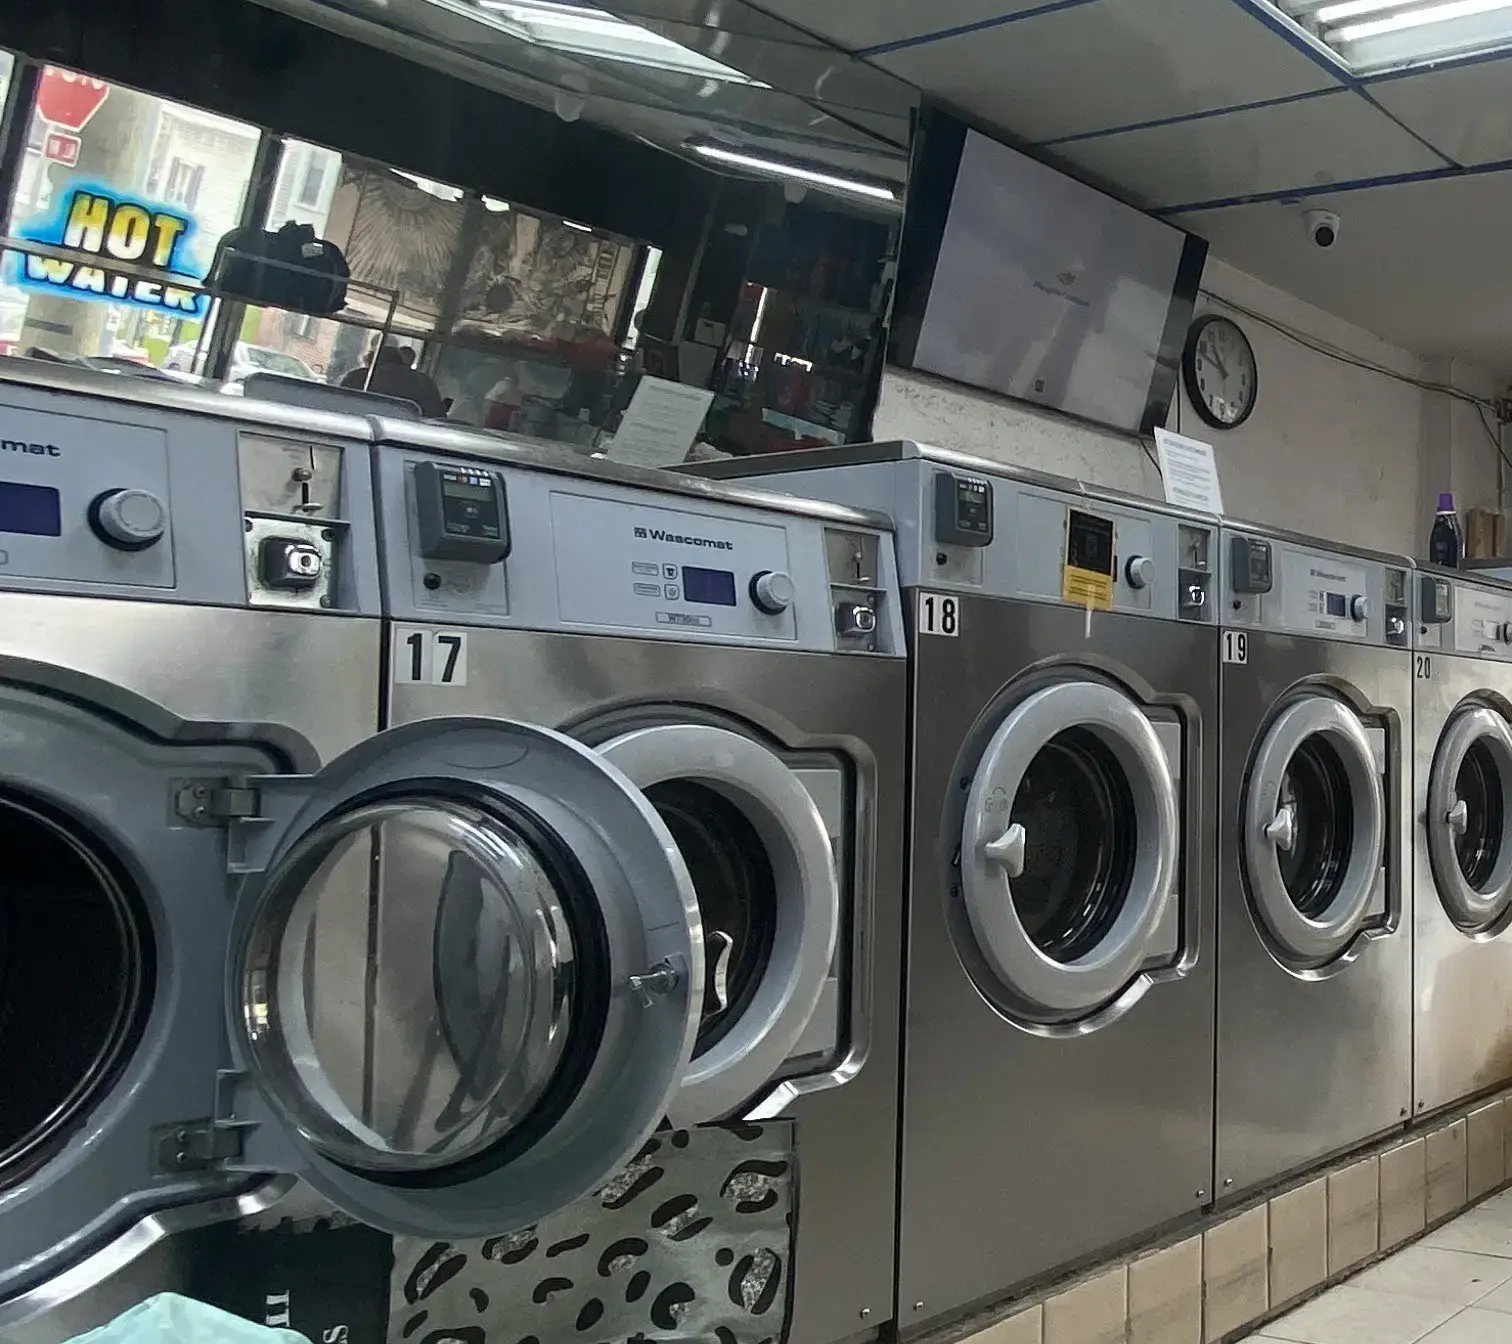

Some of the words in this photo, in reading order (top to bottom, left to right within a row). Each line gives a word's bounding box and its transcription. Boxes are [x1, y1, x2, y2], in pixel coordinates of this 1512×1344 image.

[63, 192, 187, 269] HOT
[648, 528, 734, 550] Wascomat
[924, 596, 956, 634] 18
[406, 632, 463, 683] 17
[1226, 632, 1248, 662] 19
[1416, 656, 1431, 680] 20
